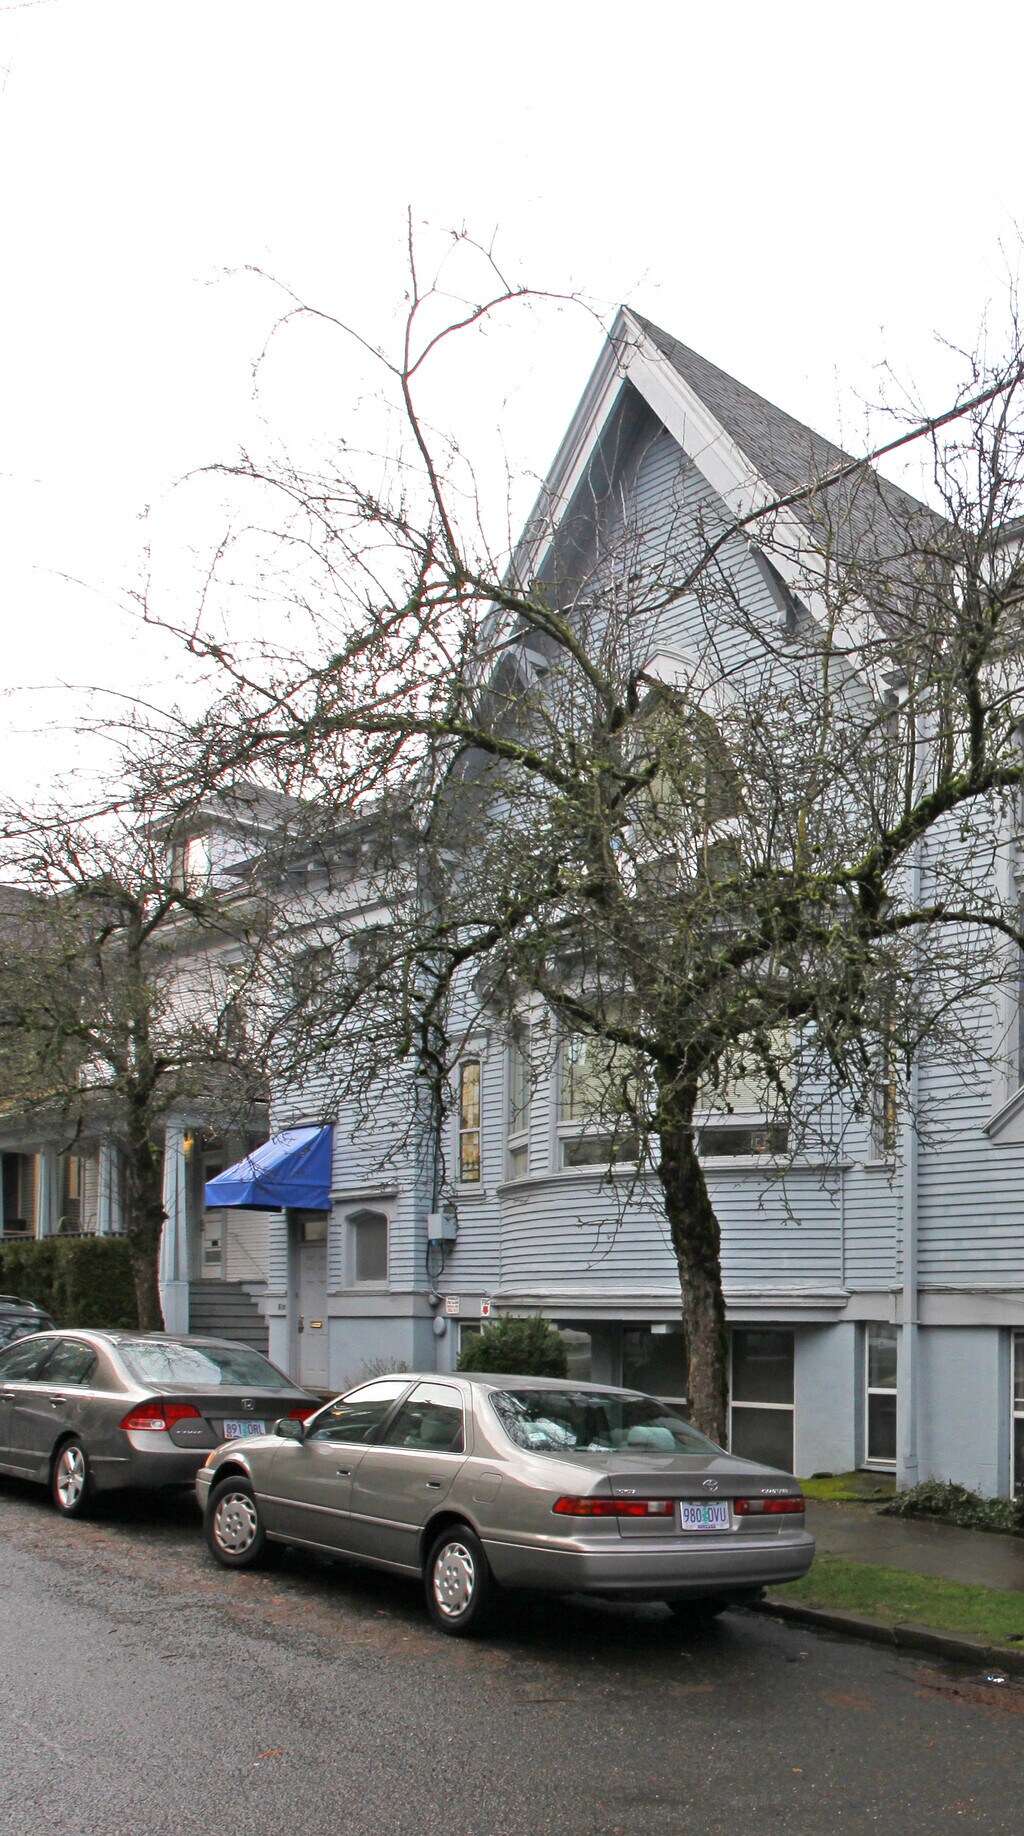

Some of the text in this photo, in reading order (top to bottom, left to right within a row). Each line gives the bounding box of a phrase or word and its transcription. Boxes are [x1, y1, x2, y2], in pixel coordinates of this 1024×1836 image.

[226, 1423, 242, 1434] 891
[683, 1507, 726, 1523] 980 DVU
